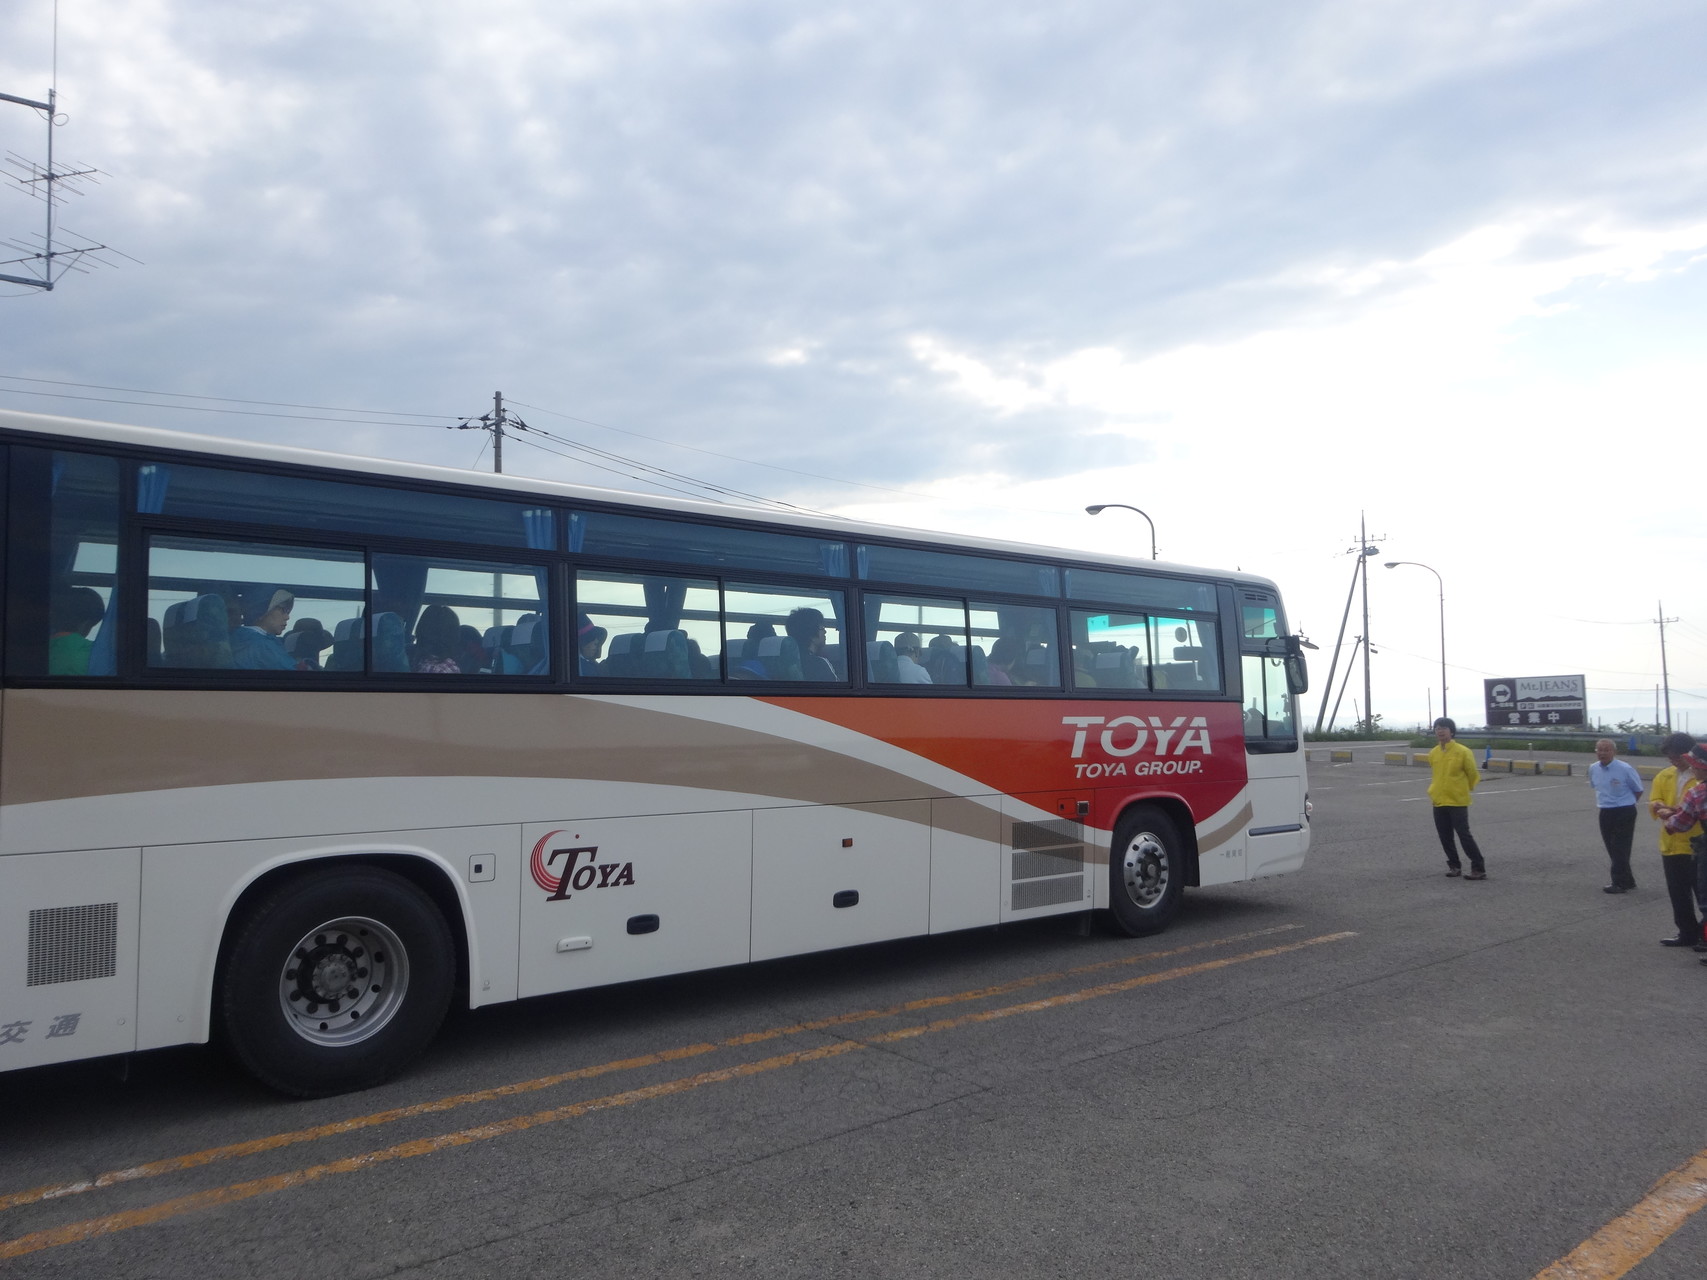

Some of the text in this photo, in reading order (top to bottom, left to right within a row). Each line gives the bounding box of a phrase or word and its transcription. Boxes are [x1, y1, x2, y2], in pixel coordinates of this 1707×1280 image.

[1061, 715, 1212, 758] TOYA
[1074, 760, 1203, 779] TOYA GROUP.
[0, 1012, 82, 1046] 交通
